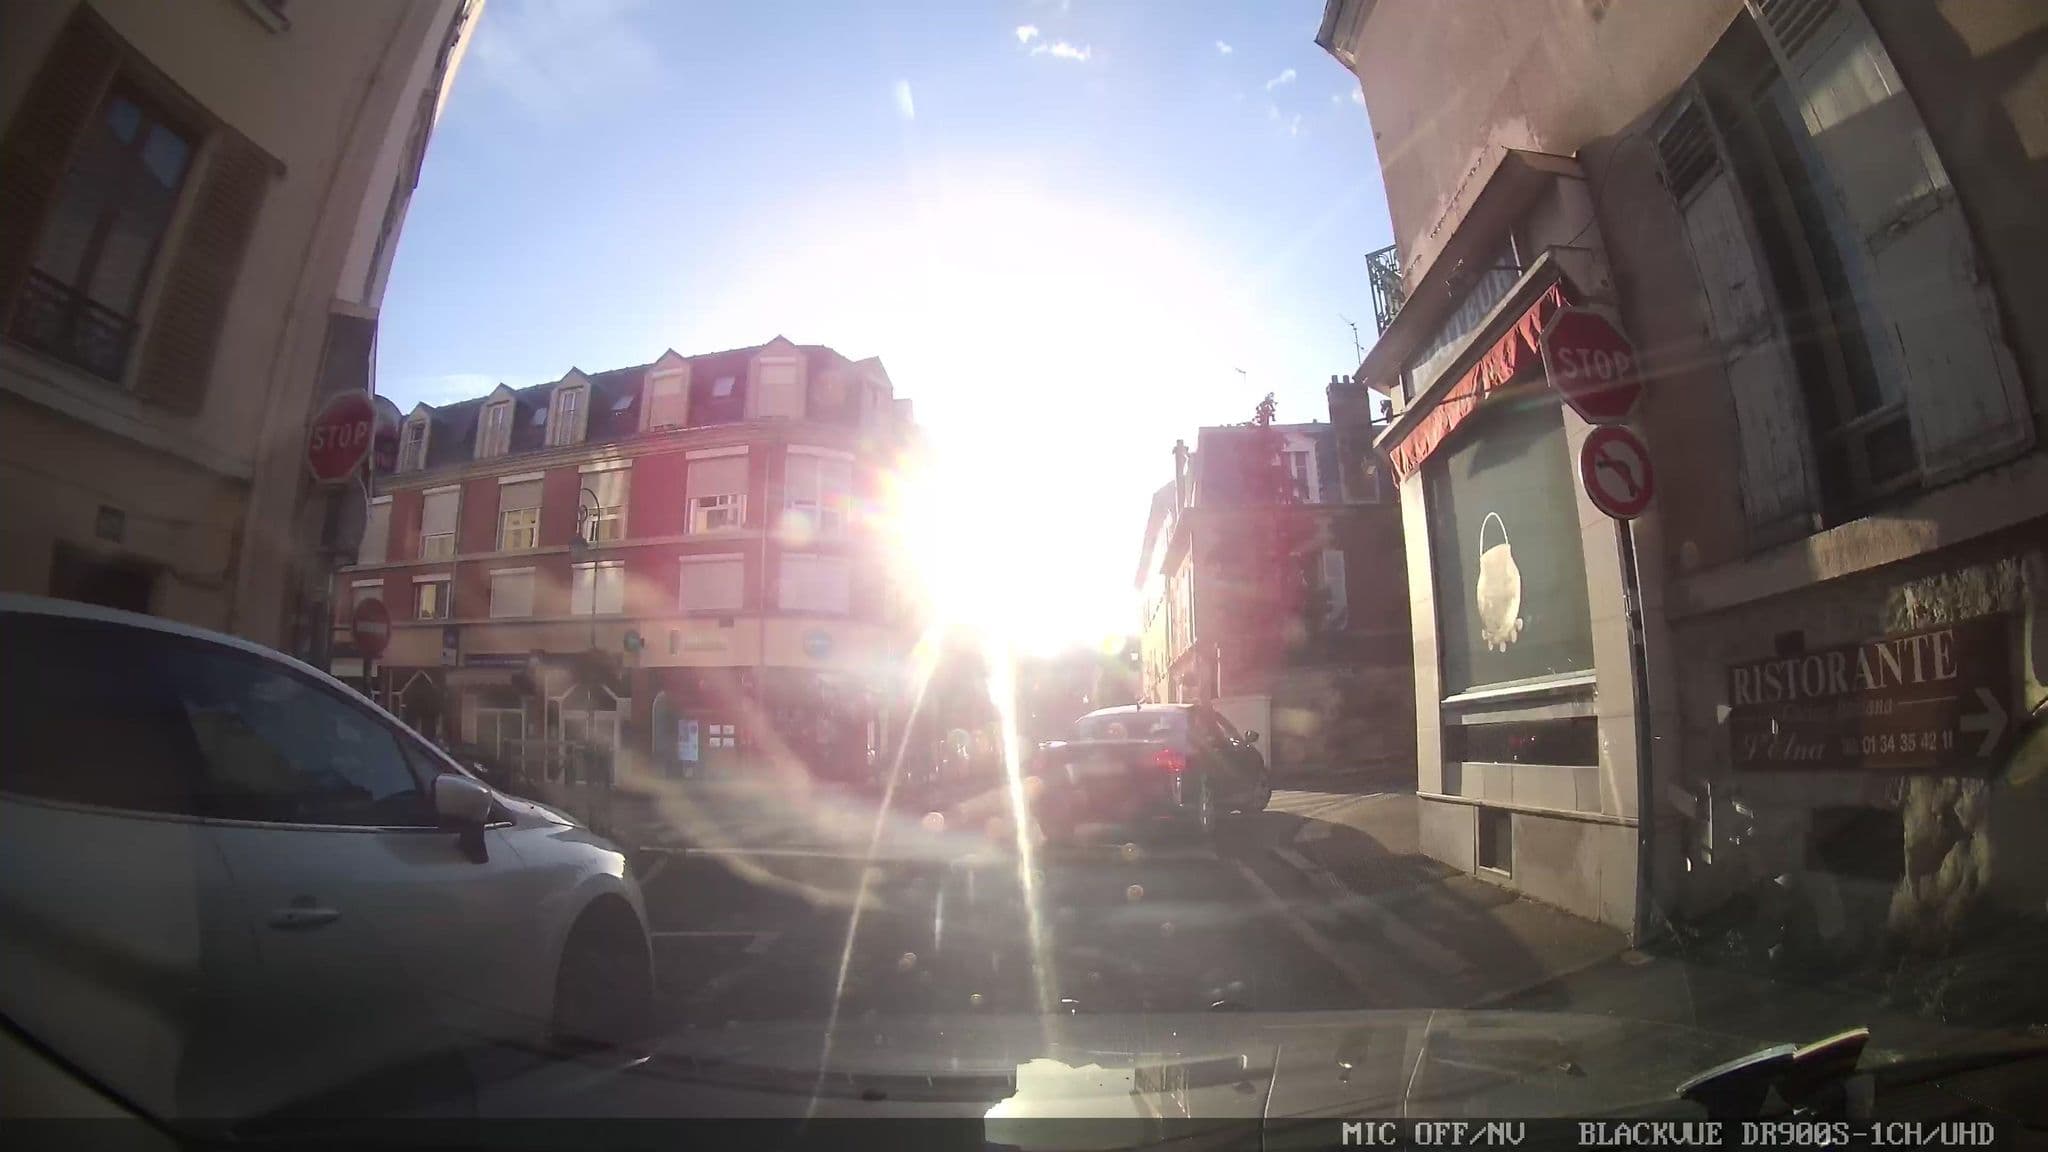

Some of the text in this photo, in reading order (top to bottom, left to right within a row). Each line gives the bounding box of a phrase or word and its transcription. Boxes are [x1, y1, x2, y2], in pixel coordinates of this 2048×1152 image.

[1559, 347, 1629, 380] STOP
[312, 421, 369, 449] STOP
[1733, 630, 1958, 705] RISTORANTE
[1862, 735, 1876, 754] 01
[1880, 734, 1895, 753] 34
